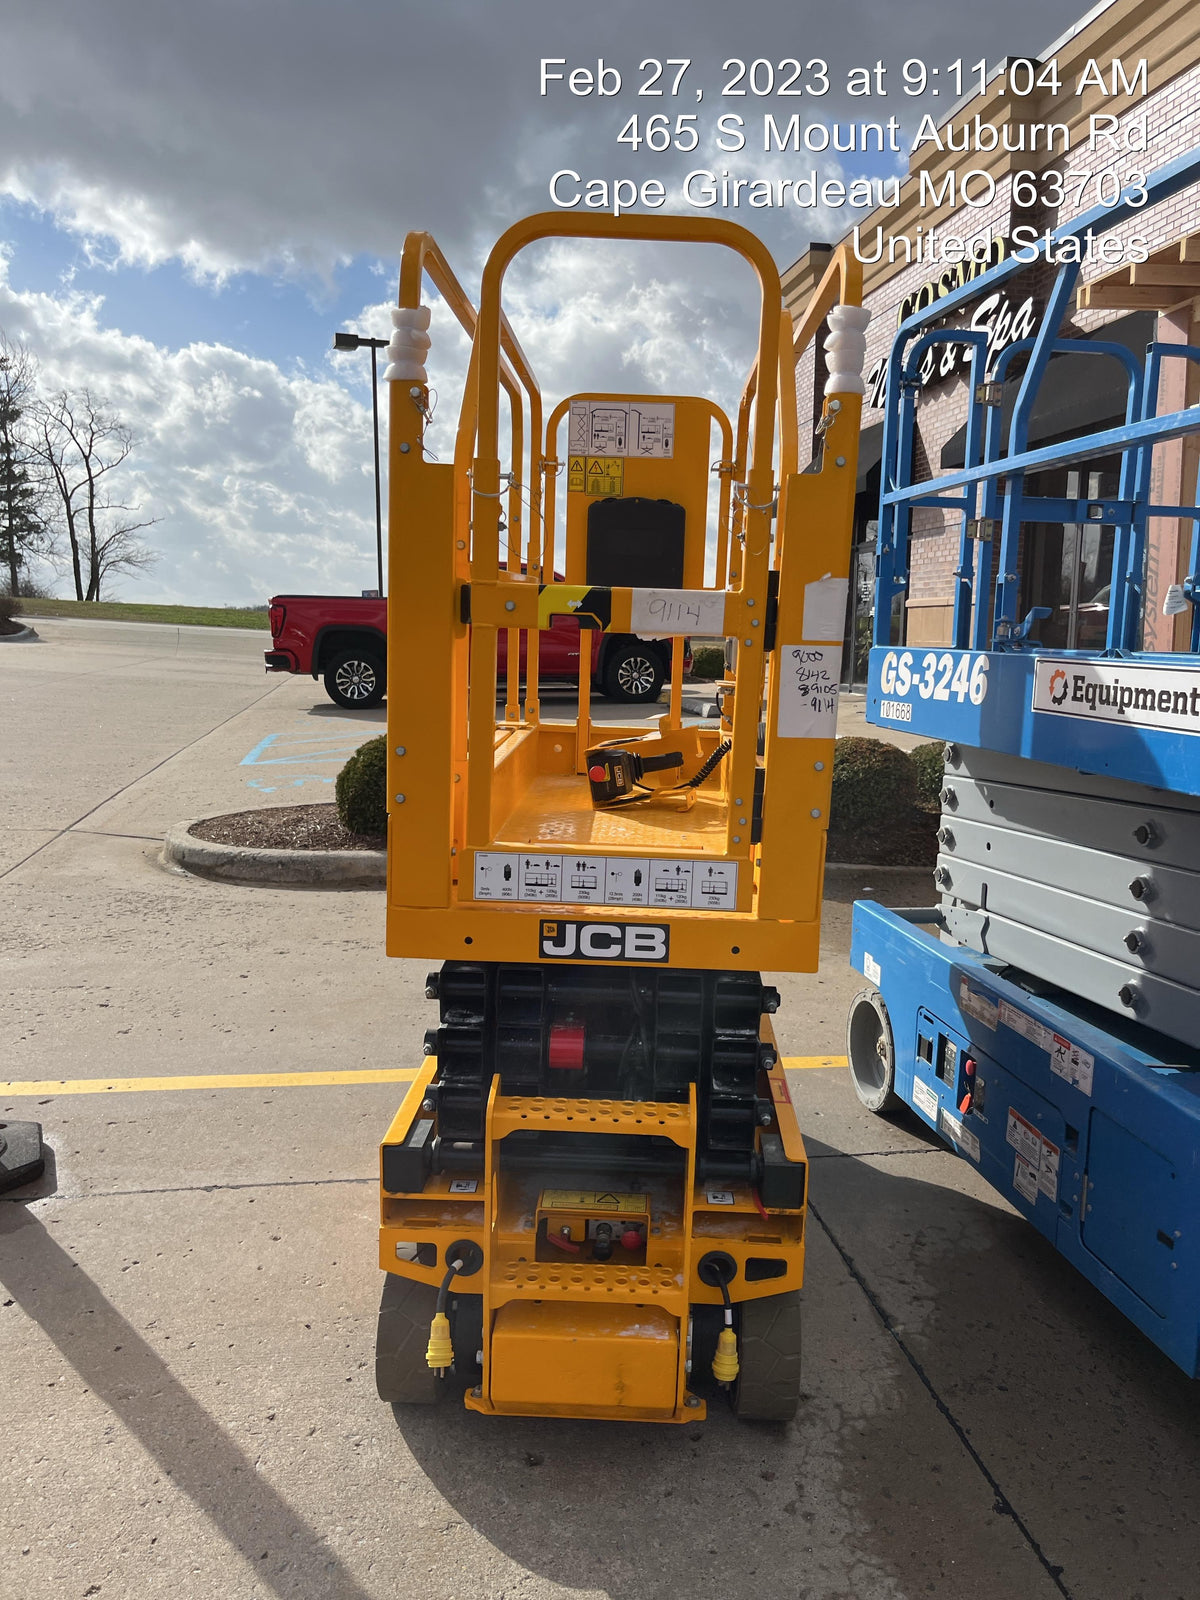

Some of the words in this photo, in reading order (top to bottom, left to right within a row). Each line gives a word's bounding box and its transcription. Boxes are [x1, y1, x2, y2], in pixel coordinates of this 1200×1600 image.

[962, 293, 1037, 375] Spa
[648, 599, 701, 625] 9114
[881, 651, 990, 705] GS-3246
[1071, 674, 1200, 717] Equipment
[881, 701, 912, 721] 101668
[542, 923, 667, 959] JCB
